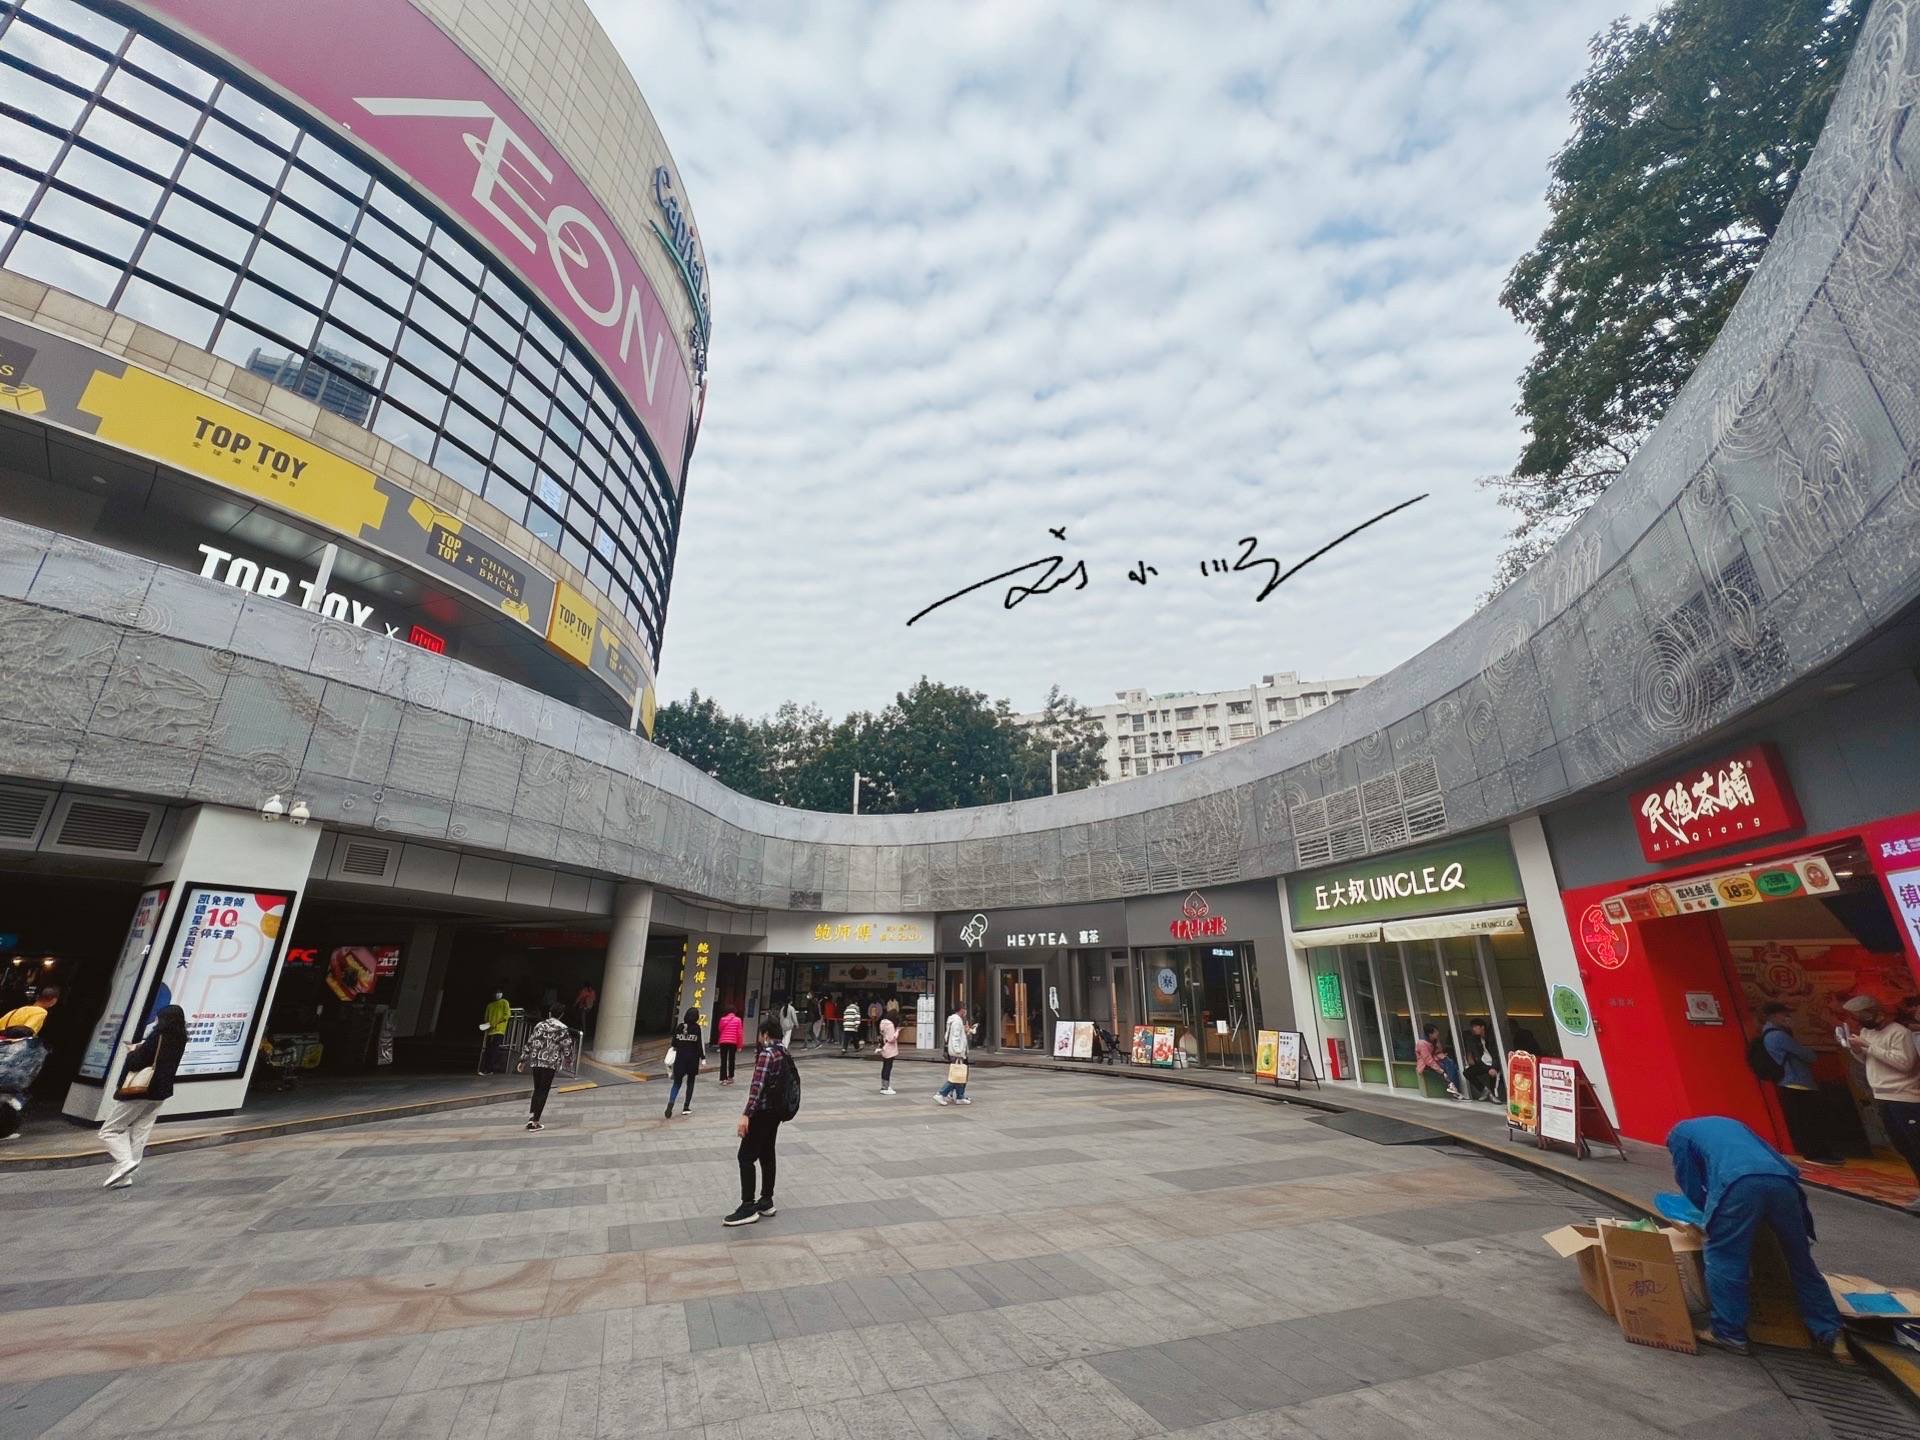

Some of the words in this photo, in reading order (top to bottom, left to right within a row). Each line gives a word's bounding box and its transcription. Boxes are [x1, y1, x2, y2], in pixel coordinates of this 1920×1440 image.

[352, 97, 664, 406] AEON
[195, 416, 251, 453] TOP
[258, 442, 308, 480] TOY
[437, 543, 459, 563] TOY
[440, 531, 461, 550] TOP
[198, 543, 290, 598] TOP
[479, 568, 519, 597] BRICKS
[481, 557, 515, 583] CHINA
[560, 603, 576, 626] TOP
[577, 617, 592, 640] TOY
[1315, 878, 1368, 911] 丘大叔
[207, 908, 239, 928] 10
[814, 922, 872, 943] 鲍师傅
[1007, 932, 1068, 947] HEYTEA
[1079, 929, 1099, 944] 喜茶
[694, 943, 710, 983] 鲍师傅
